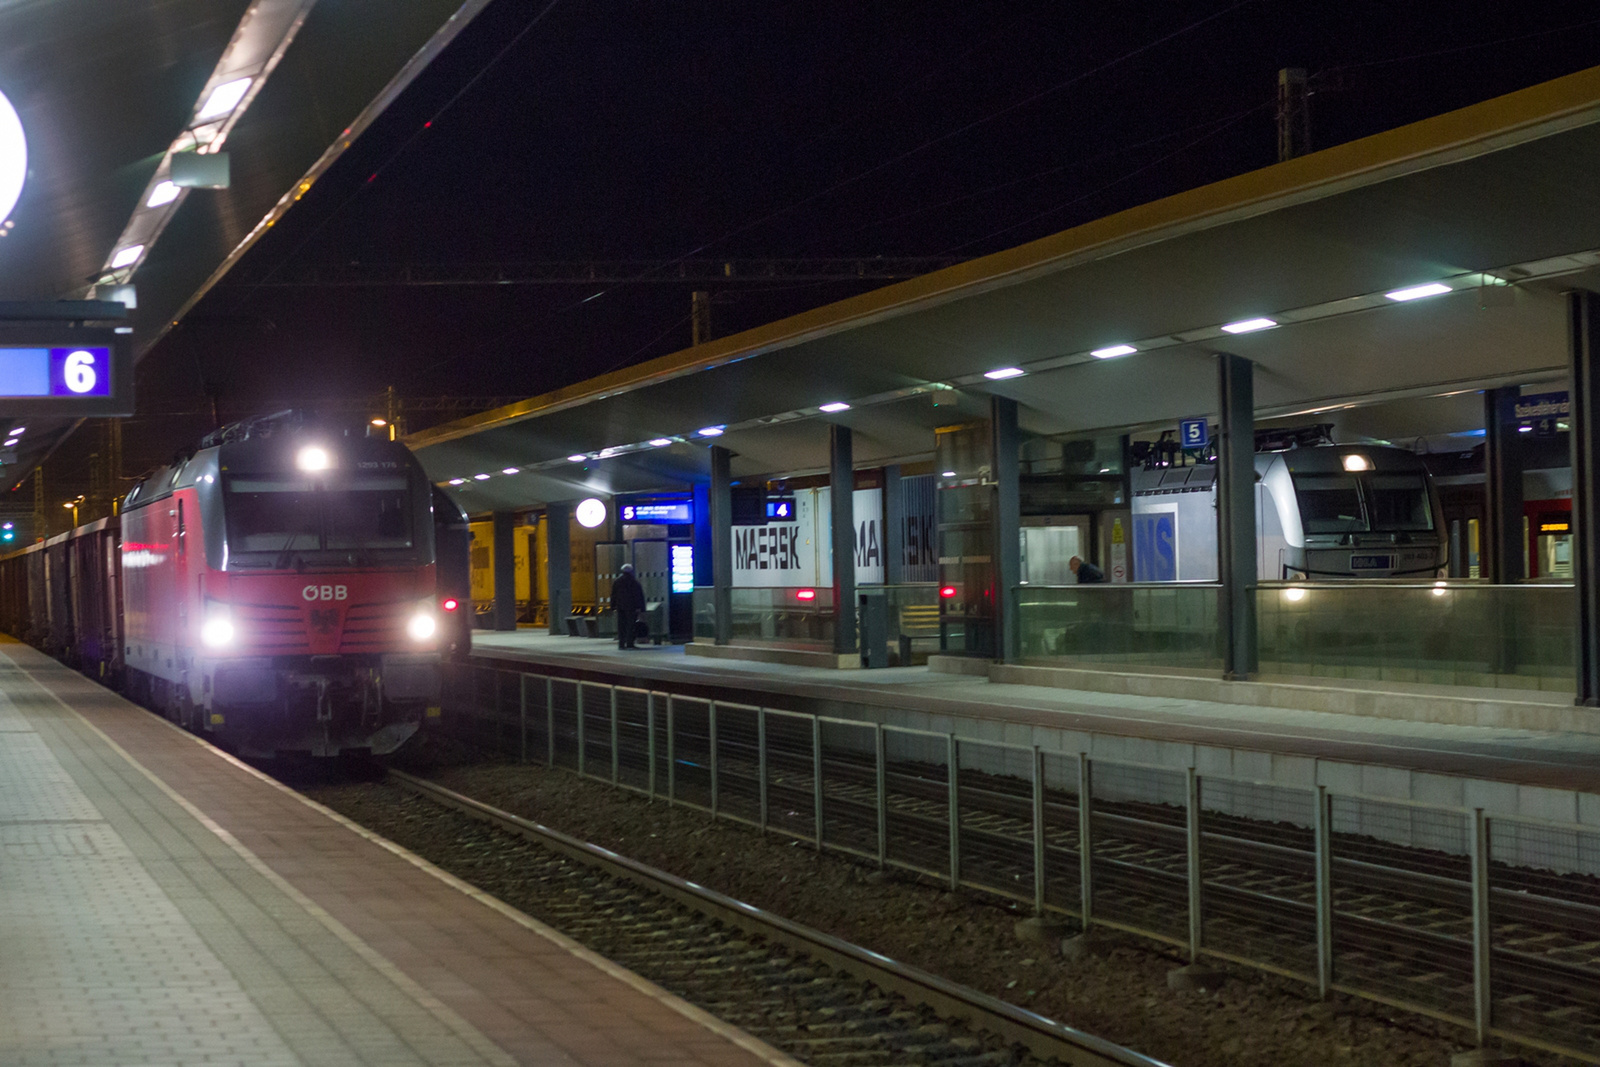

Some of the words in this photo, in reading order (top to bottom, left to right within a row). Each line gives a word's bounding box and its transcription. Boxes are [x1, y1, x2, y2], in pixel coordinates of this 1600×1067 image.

[64, 350, 97, 393] 6
[1189, 423, 1201, 439] 5
[623, 506, 635, 520] 5
[776, 503, 788, 517] 4
[735, 526, 801, 570] MAERSK
[302, 584, 348, 602] ÖBB
